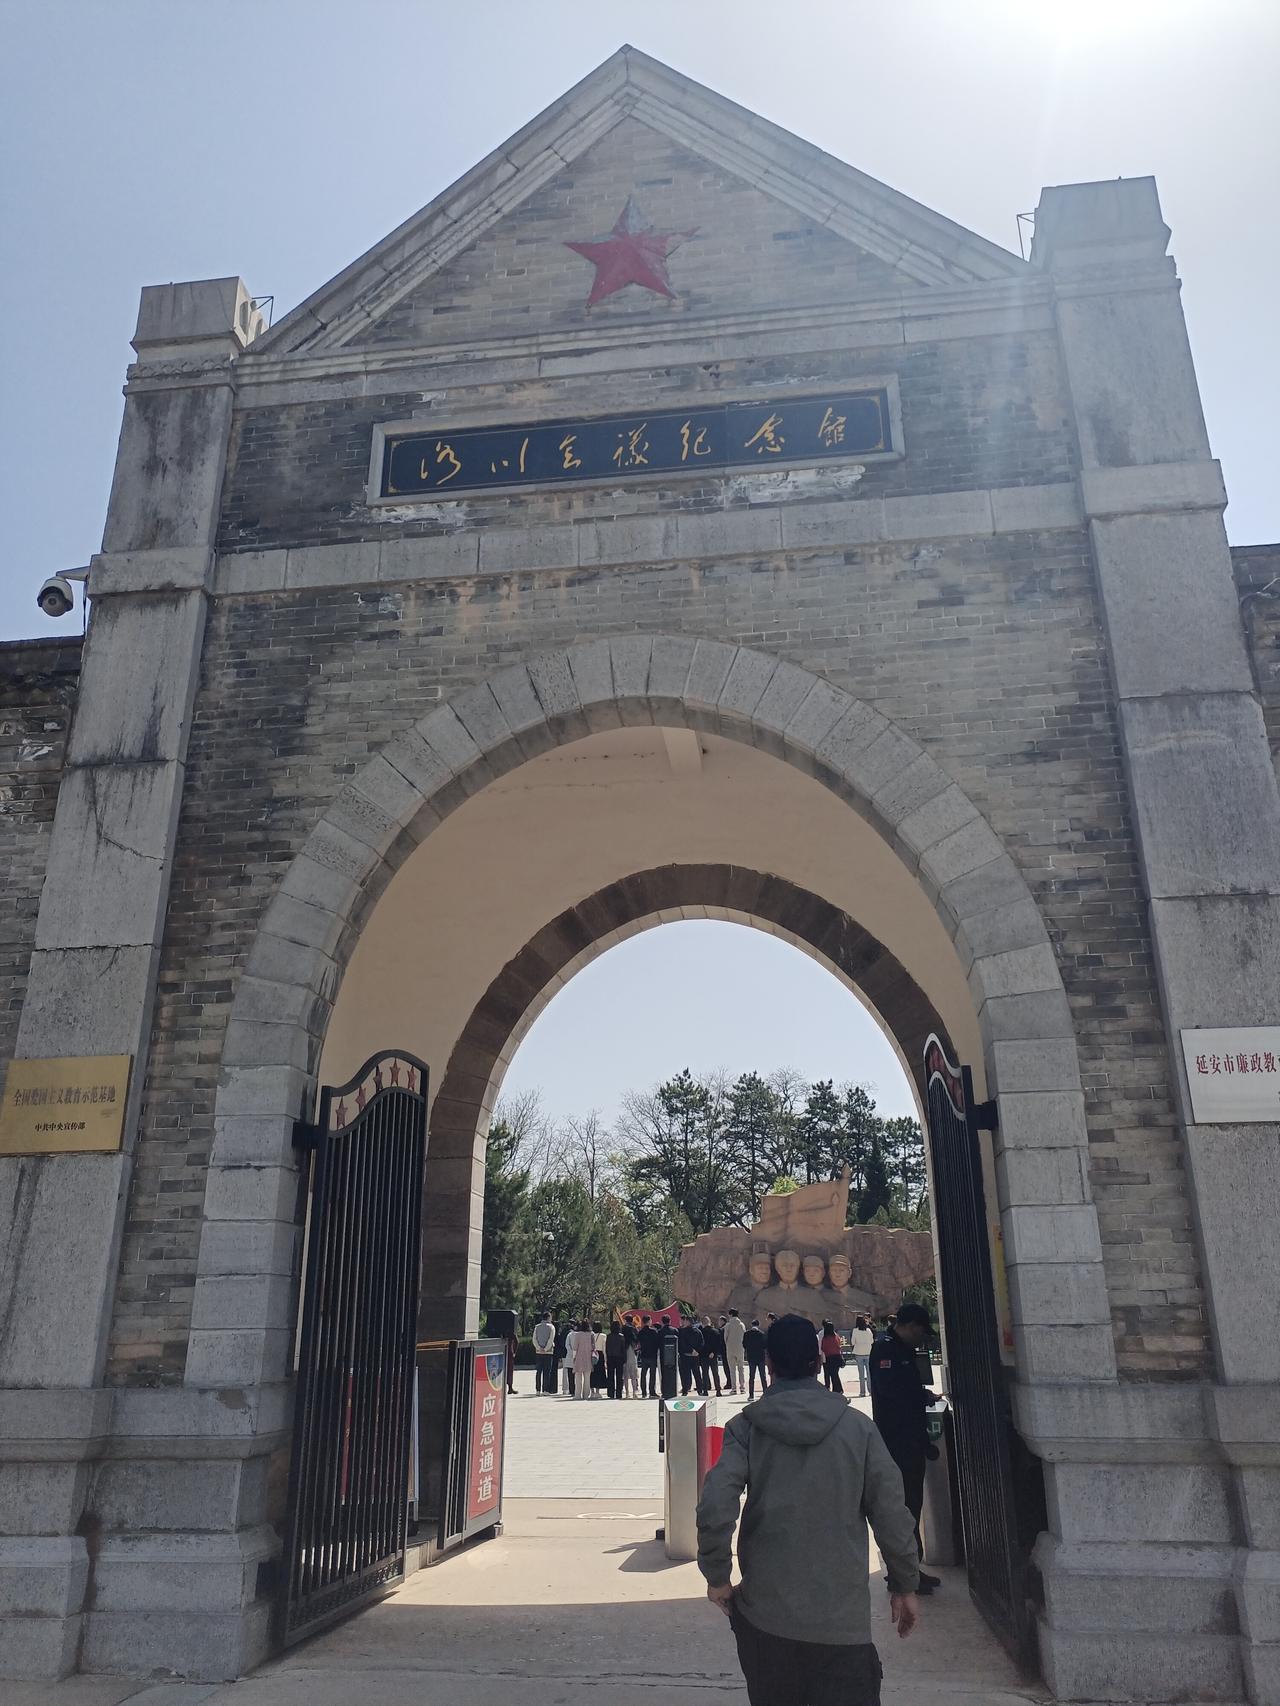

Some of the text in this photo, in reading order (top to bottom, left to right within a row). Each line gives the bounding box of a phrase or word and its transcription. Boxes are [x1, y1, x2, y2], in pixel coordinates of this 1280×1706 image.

[1196, 1051, 1280, 1075] 延安市廉政教
[14, 1085, 116, 1107] 全国爱国主义教育示范基地
[34, 1121, 86, 1132] 中共中央宣传部
[477, 1393, 497, 1504] 应急通道
